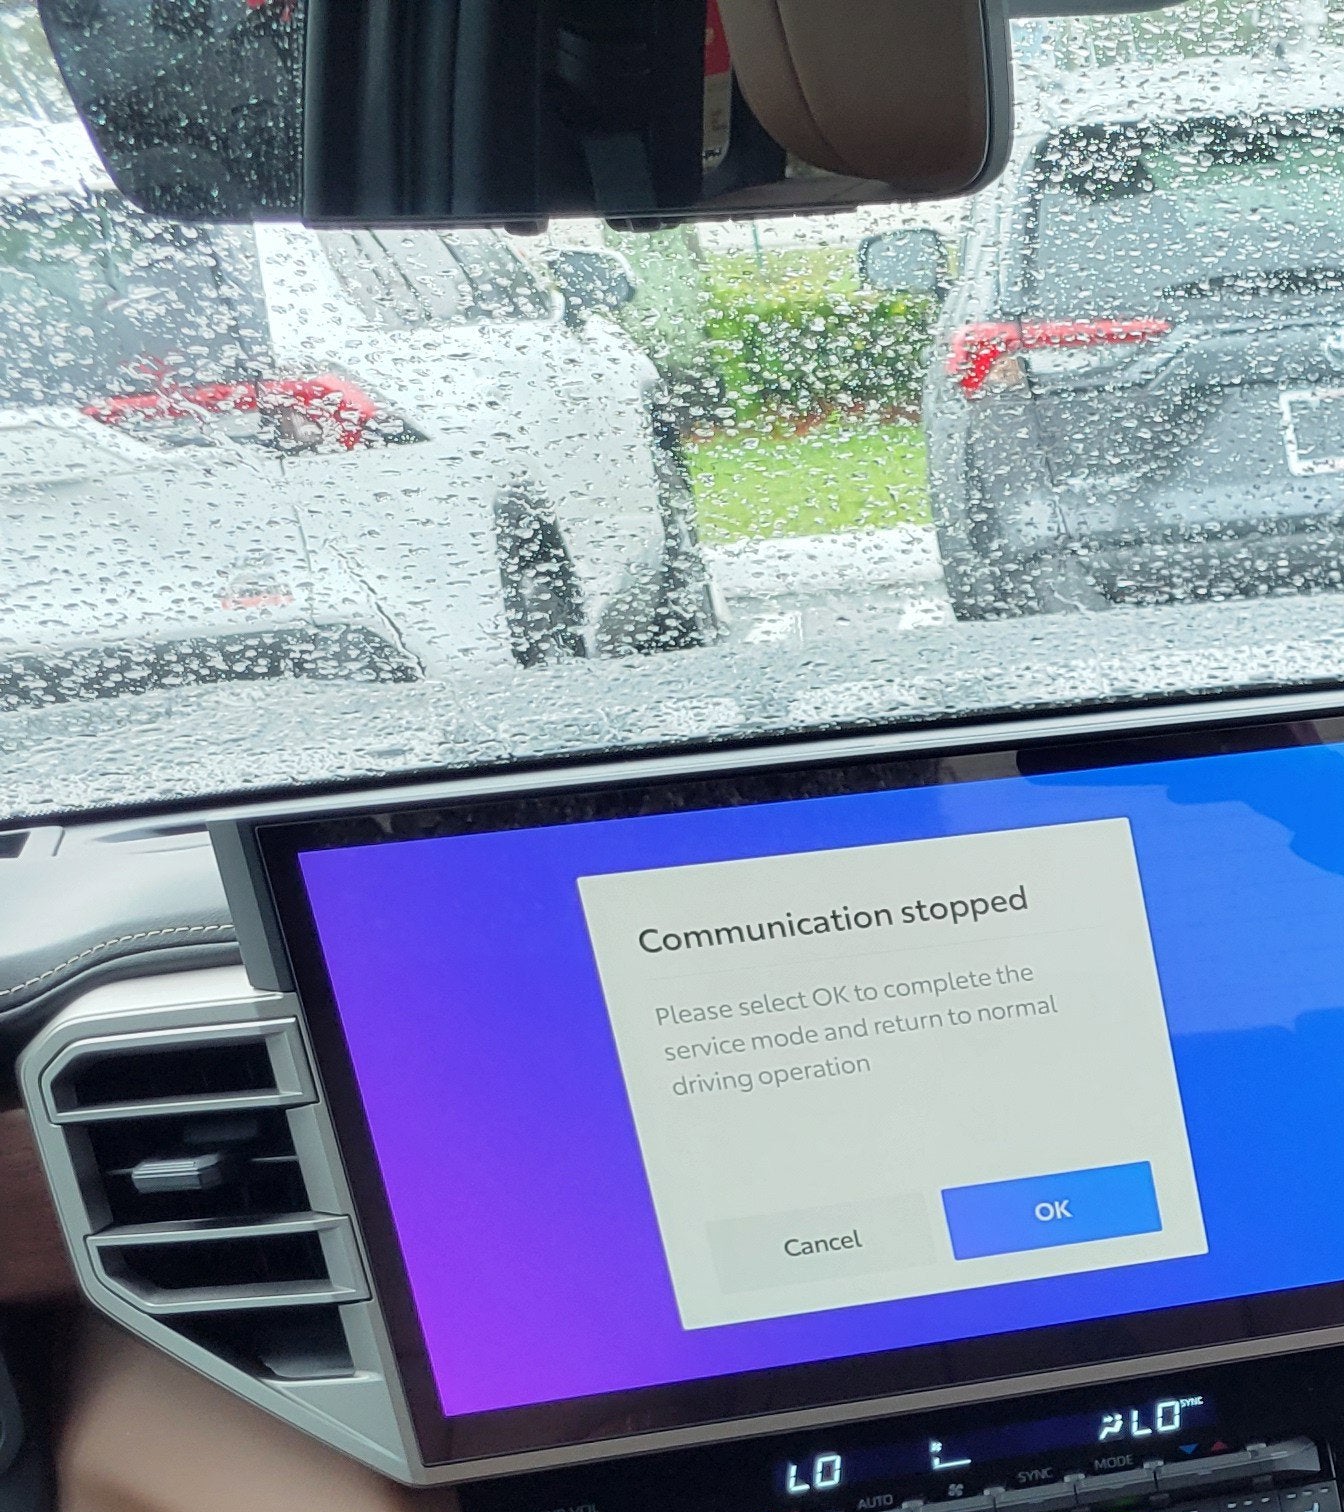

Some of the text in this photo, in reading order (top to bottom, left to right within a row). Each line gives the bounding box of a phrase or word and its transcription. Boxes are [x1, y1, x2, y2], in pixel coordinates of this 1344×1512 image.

[638, 885, 1028, 953] Communication stopped
[655, 965, 1034, 1026] Please select OK to complete the
[664, 994, 1059, 1061] service mode and return to normal
[672, 1056, 871, 1096] driving operation
[1034, 1199, 1073, 1222] OK
[784, 1229, 863, 1257] Cancel
[1180, 1396, 1204, 1408] SYNC
[1018, 1466, 1054, 1482] SYNC
[1094, 1454, 1135, 1470] MODE
[857, 1493, 894, 1510] AUTO
